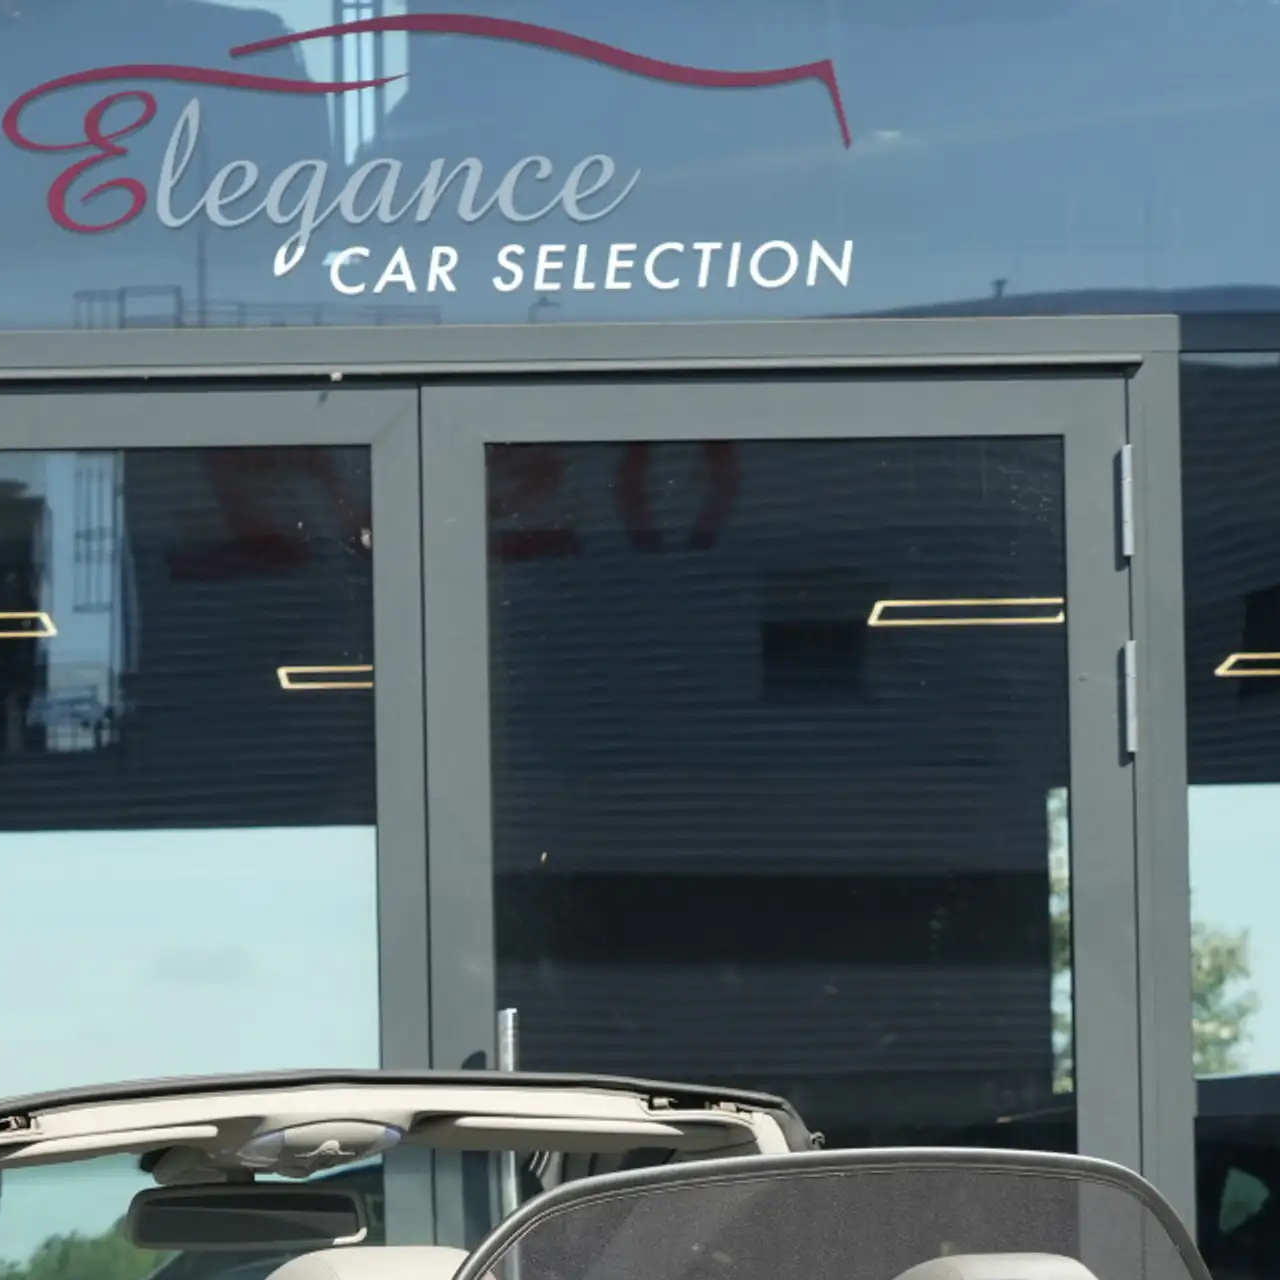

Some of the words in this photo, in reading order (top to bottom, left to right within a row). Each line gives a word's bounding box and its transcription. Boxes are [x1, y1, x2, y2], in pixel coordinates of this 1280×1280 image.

[3, 80, 641, 278] Elegance
[328, 244, 460, 297] CAR
[491, 238, 856, 293] SELECTION
